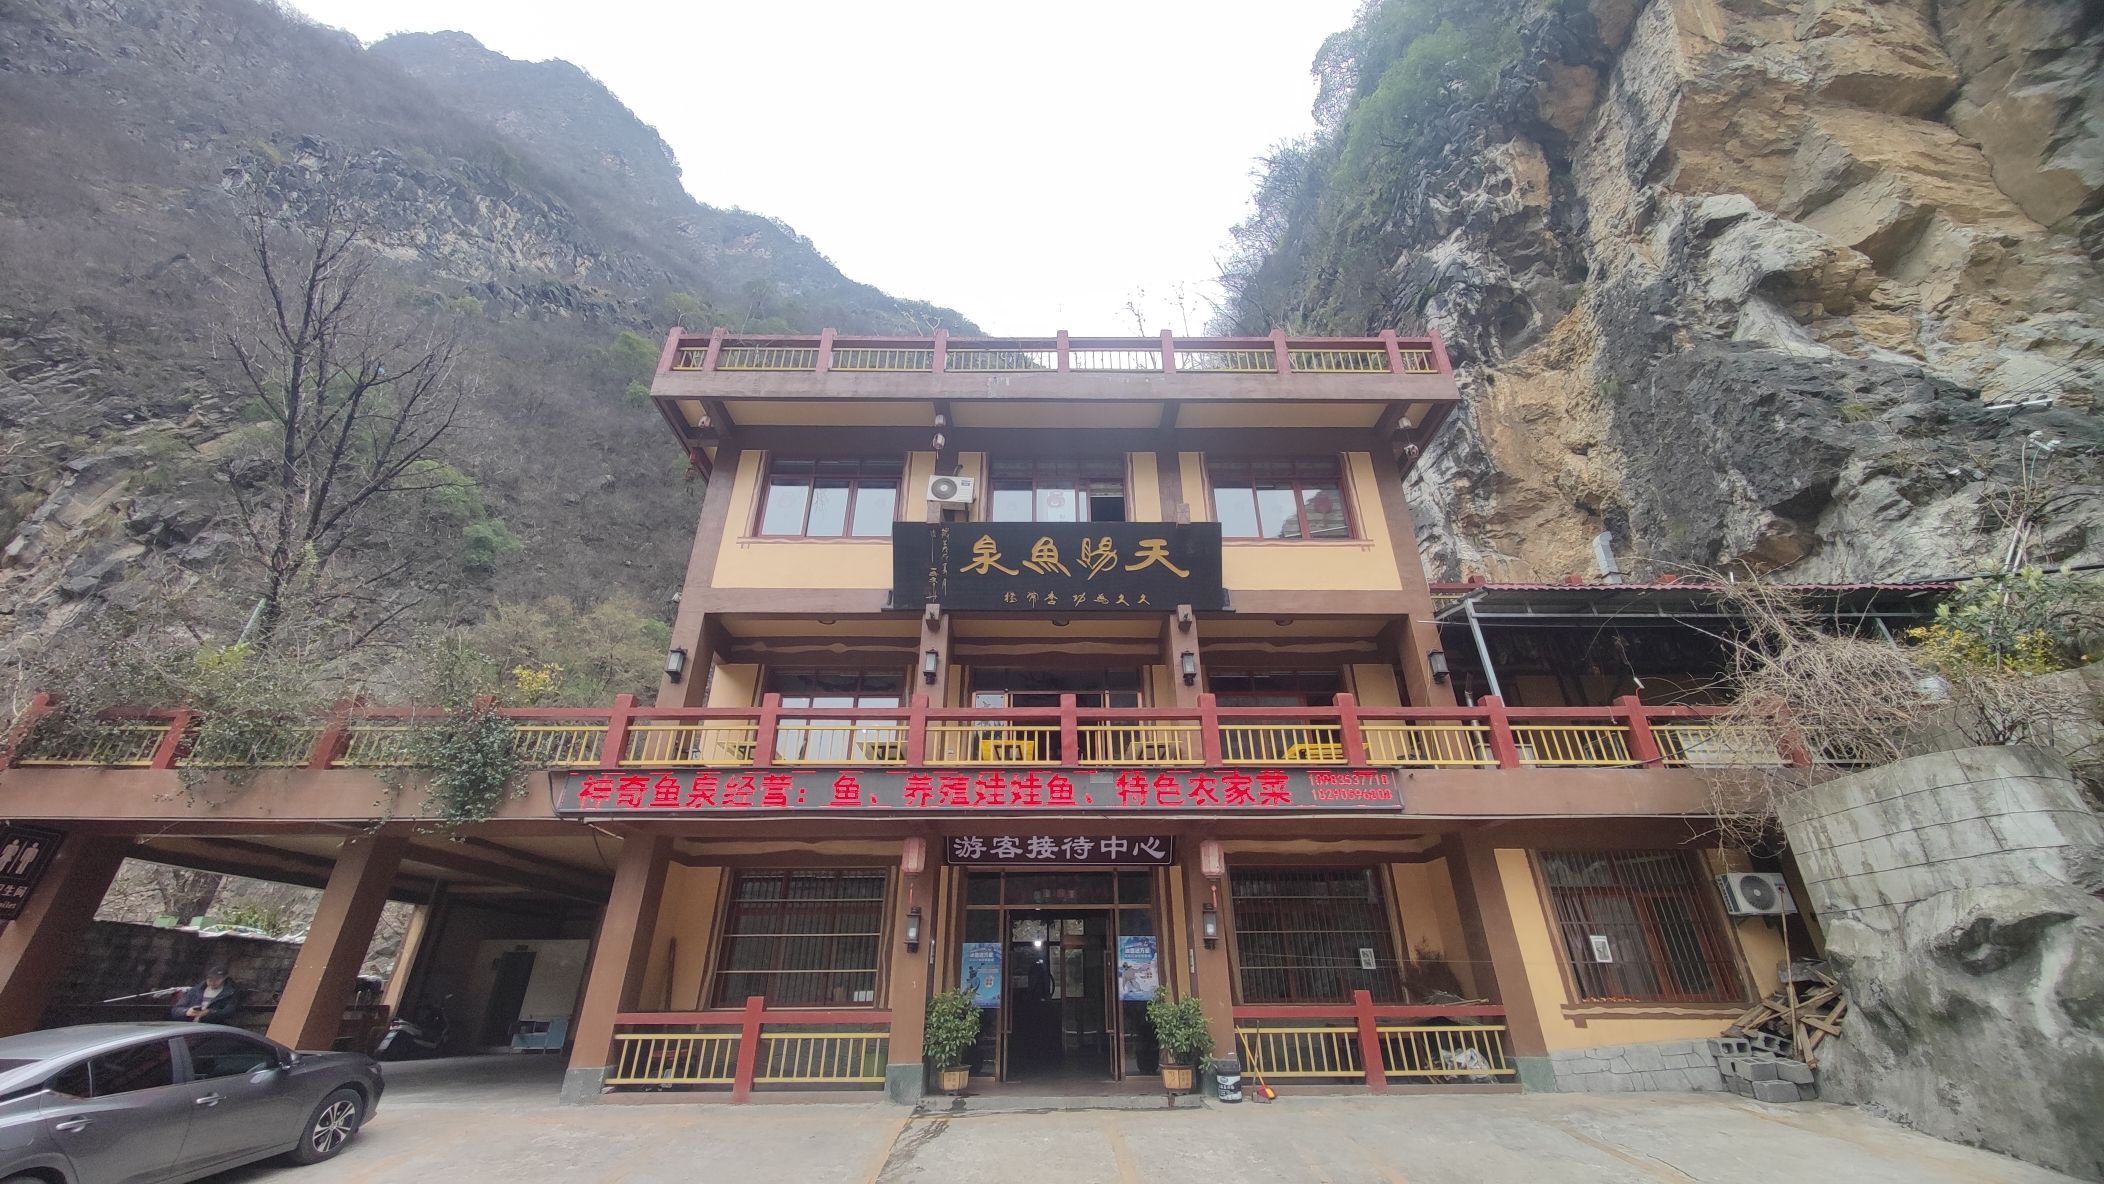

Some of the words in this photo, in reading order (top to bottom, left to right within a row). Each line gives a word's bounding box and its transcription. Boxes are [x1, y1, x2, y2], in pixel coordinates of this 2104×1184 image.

[953, 835, 1166, 860] 游客接待中心
